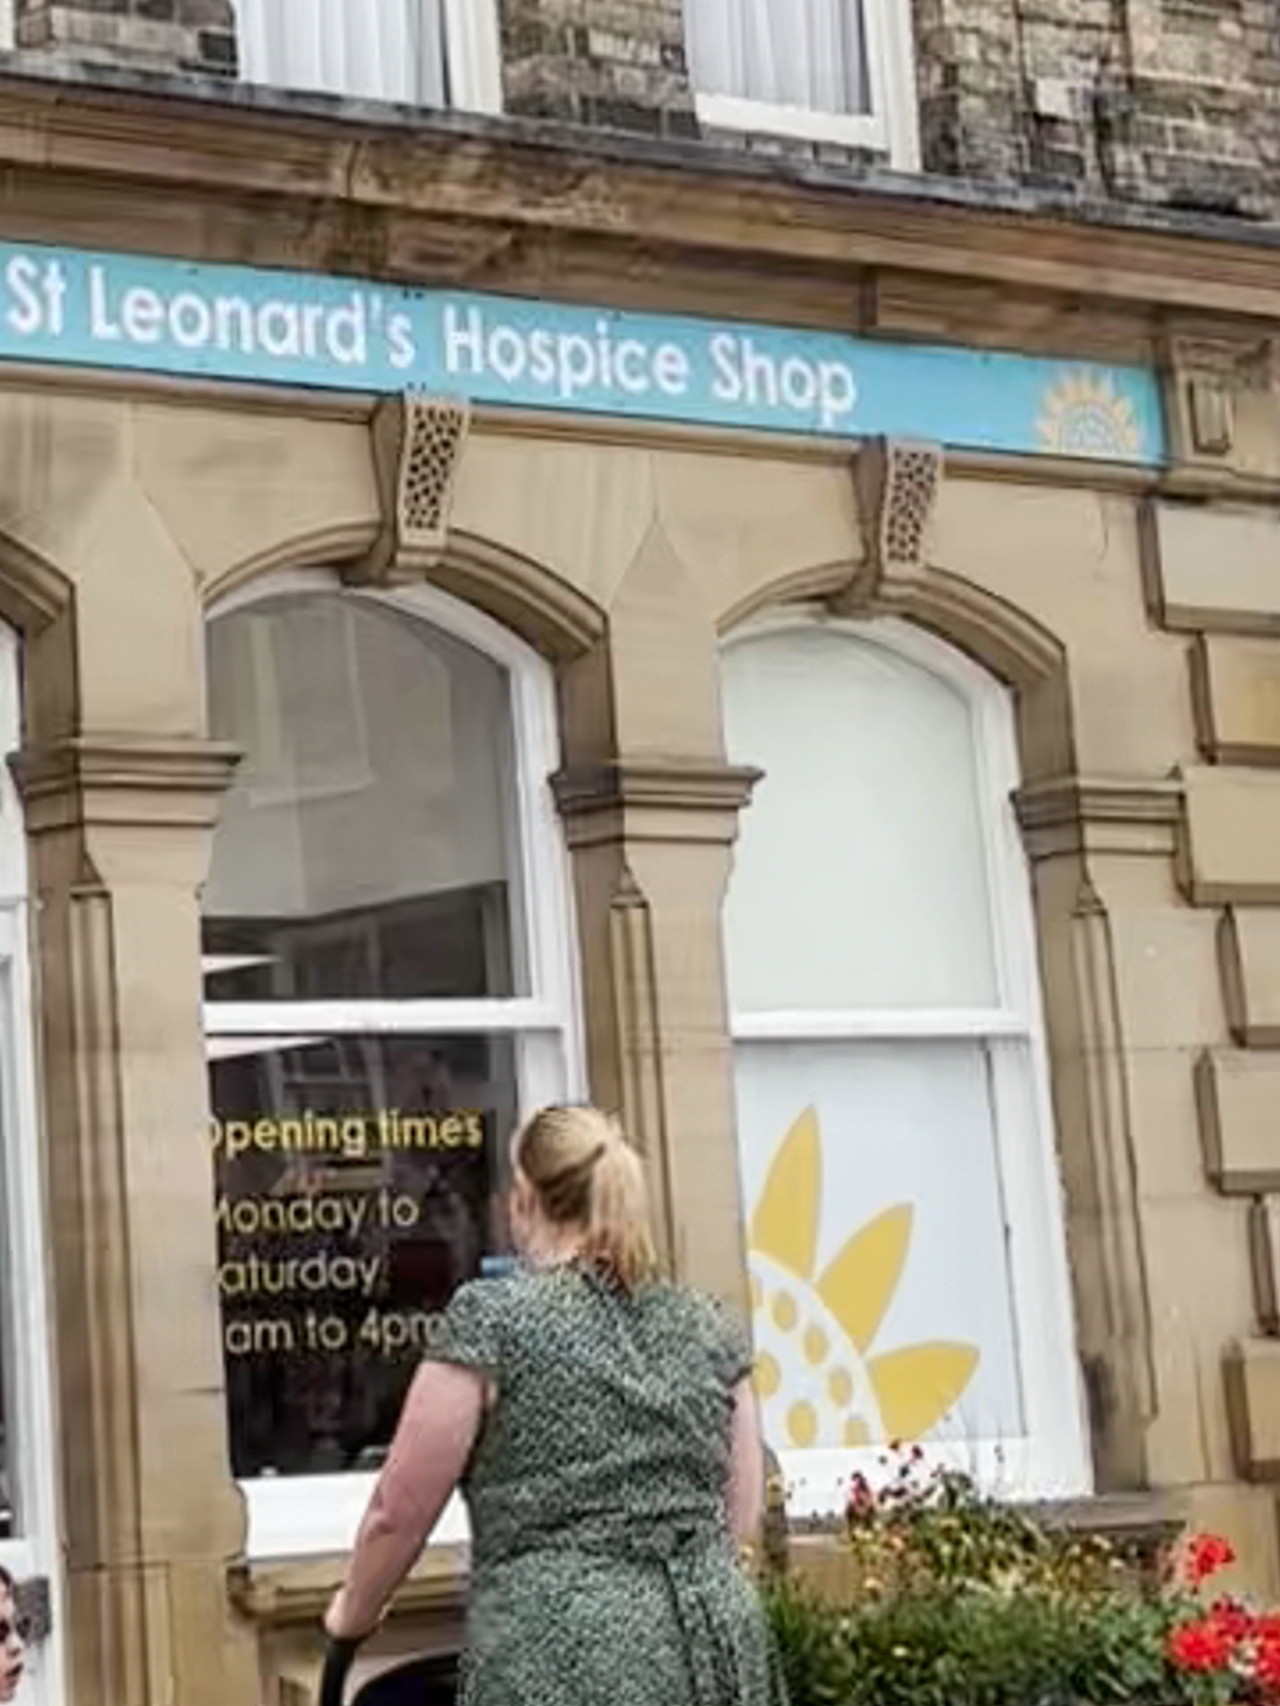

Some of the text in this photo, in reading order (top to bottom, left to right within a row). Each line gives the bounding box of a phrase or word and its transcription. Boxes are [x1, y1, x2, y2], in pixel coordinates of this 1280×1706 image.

[5, 255, 858, 427] St Leonard's Hospice Shop
[380, 1109, 482, 1148] times
[379, 1188, 419, 1226] to
[216, 1249, 380, 1295] aturday
[225, 1319, 294, 1354] am
[305, 1309, 347, 1349] to
